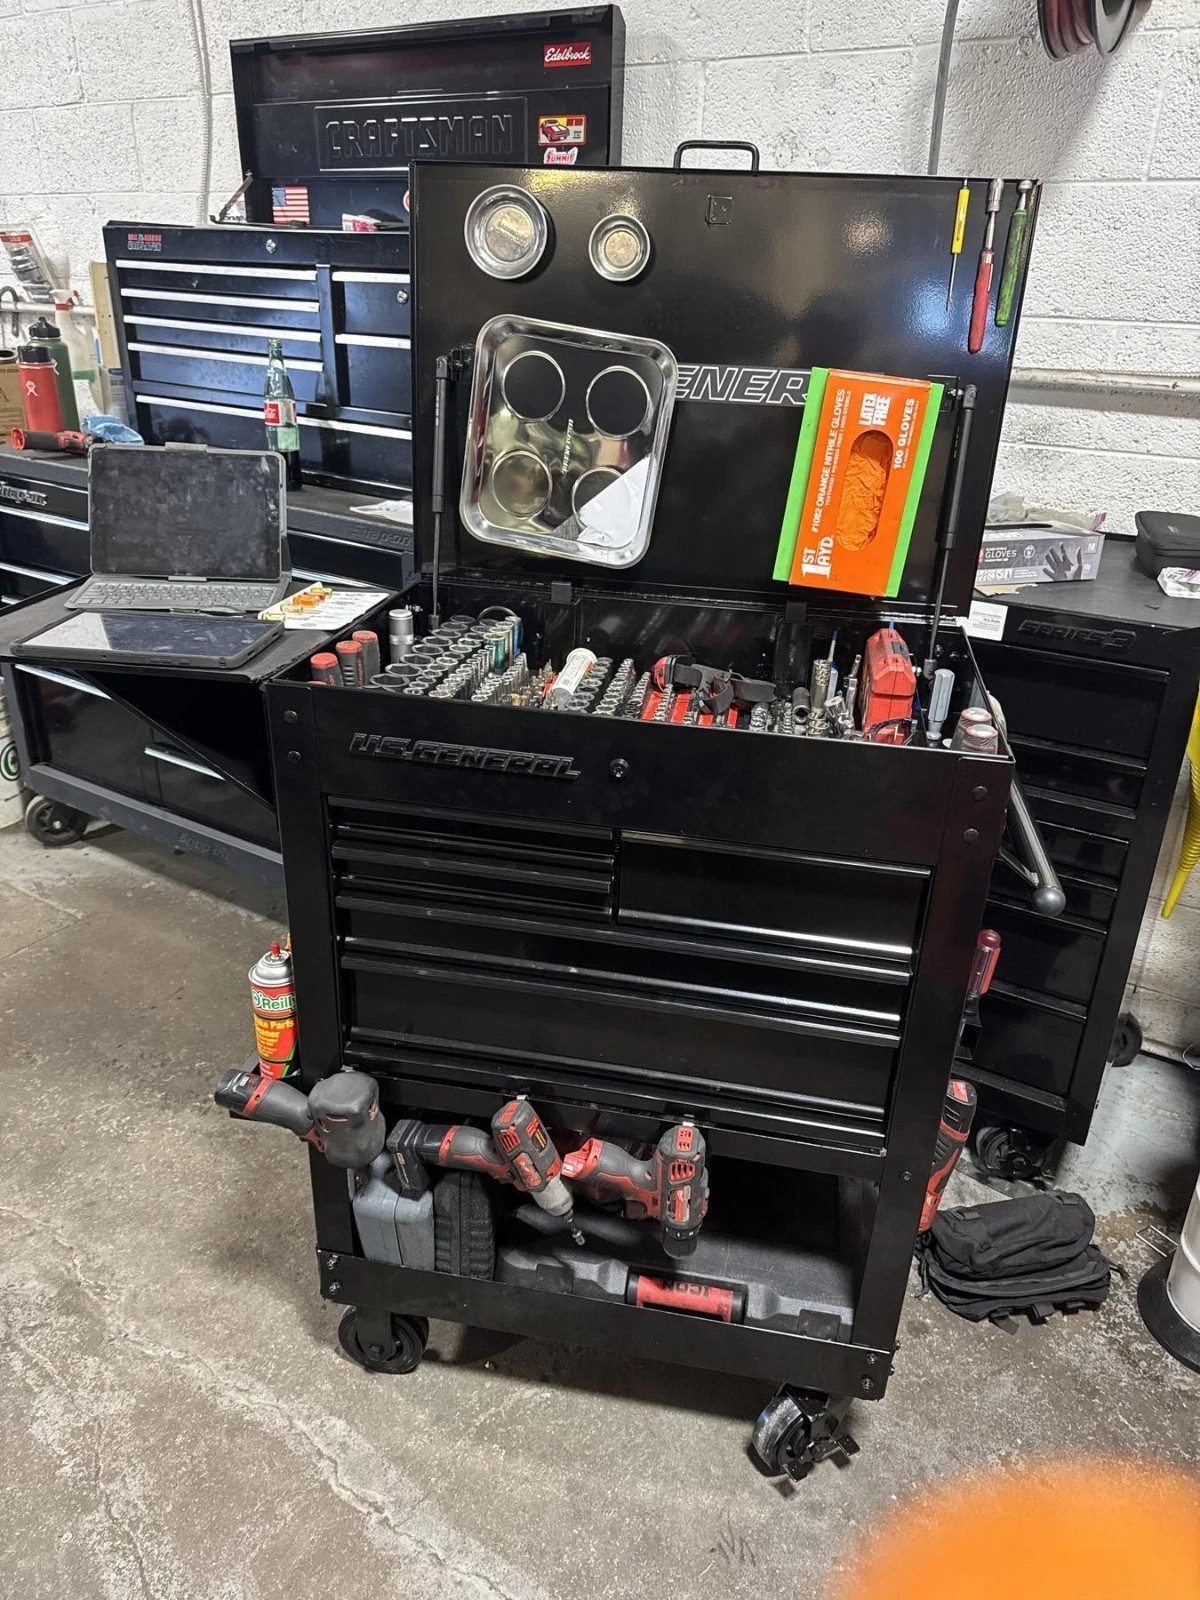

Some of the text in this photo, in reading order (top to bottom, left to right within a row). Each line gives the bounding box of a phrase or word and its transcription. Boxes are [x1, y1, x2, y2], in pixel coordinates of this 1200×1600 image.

[544, 46, 591, 62] Edelbrock
[325, 113, 513, 158] CRAFTSMAN
[545, 150, 575, 163] SUMMIT
[829, 388, 846, 427] GLOVES
[858, 393, 877, 426] LATEX
[872, 395, 891, 426] FREE
[823, 429, 837, 464] NITRILE
[892, 397, 915, 470] 100 GLOVES
[814, 465, 831, 507] ORANGE
[817, 536, 835, 566] AYD
[985, 550, 1017, 559] GLOVES
[1087, 542, 1097, 552] M
[270, 1019, 295, 1029] Parts
[661, 1279, 712, 1298] ICON
